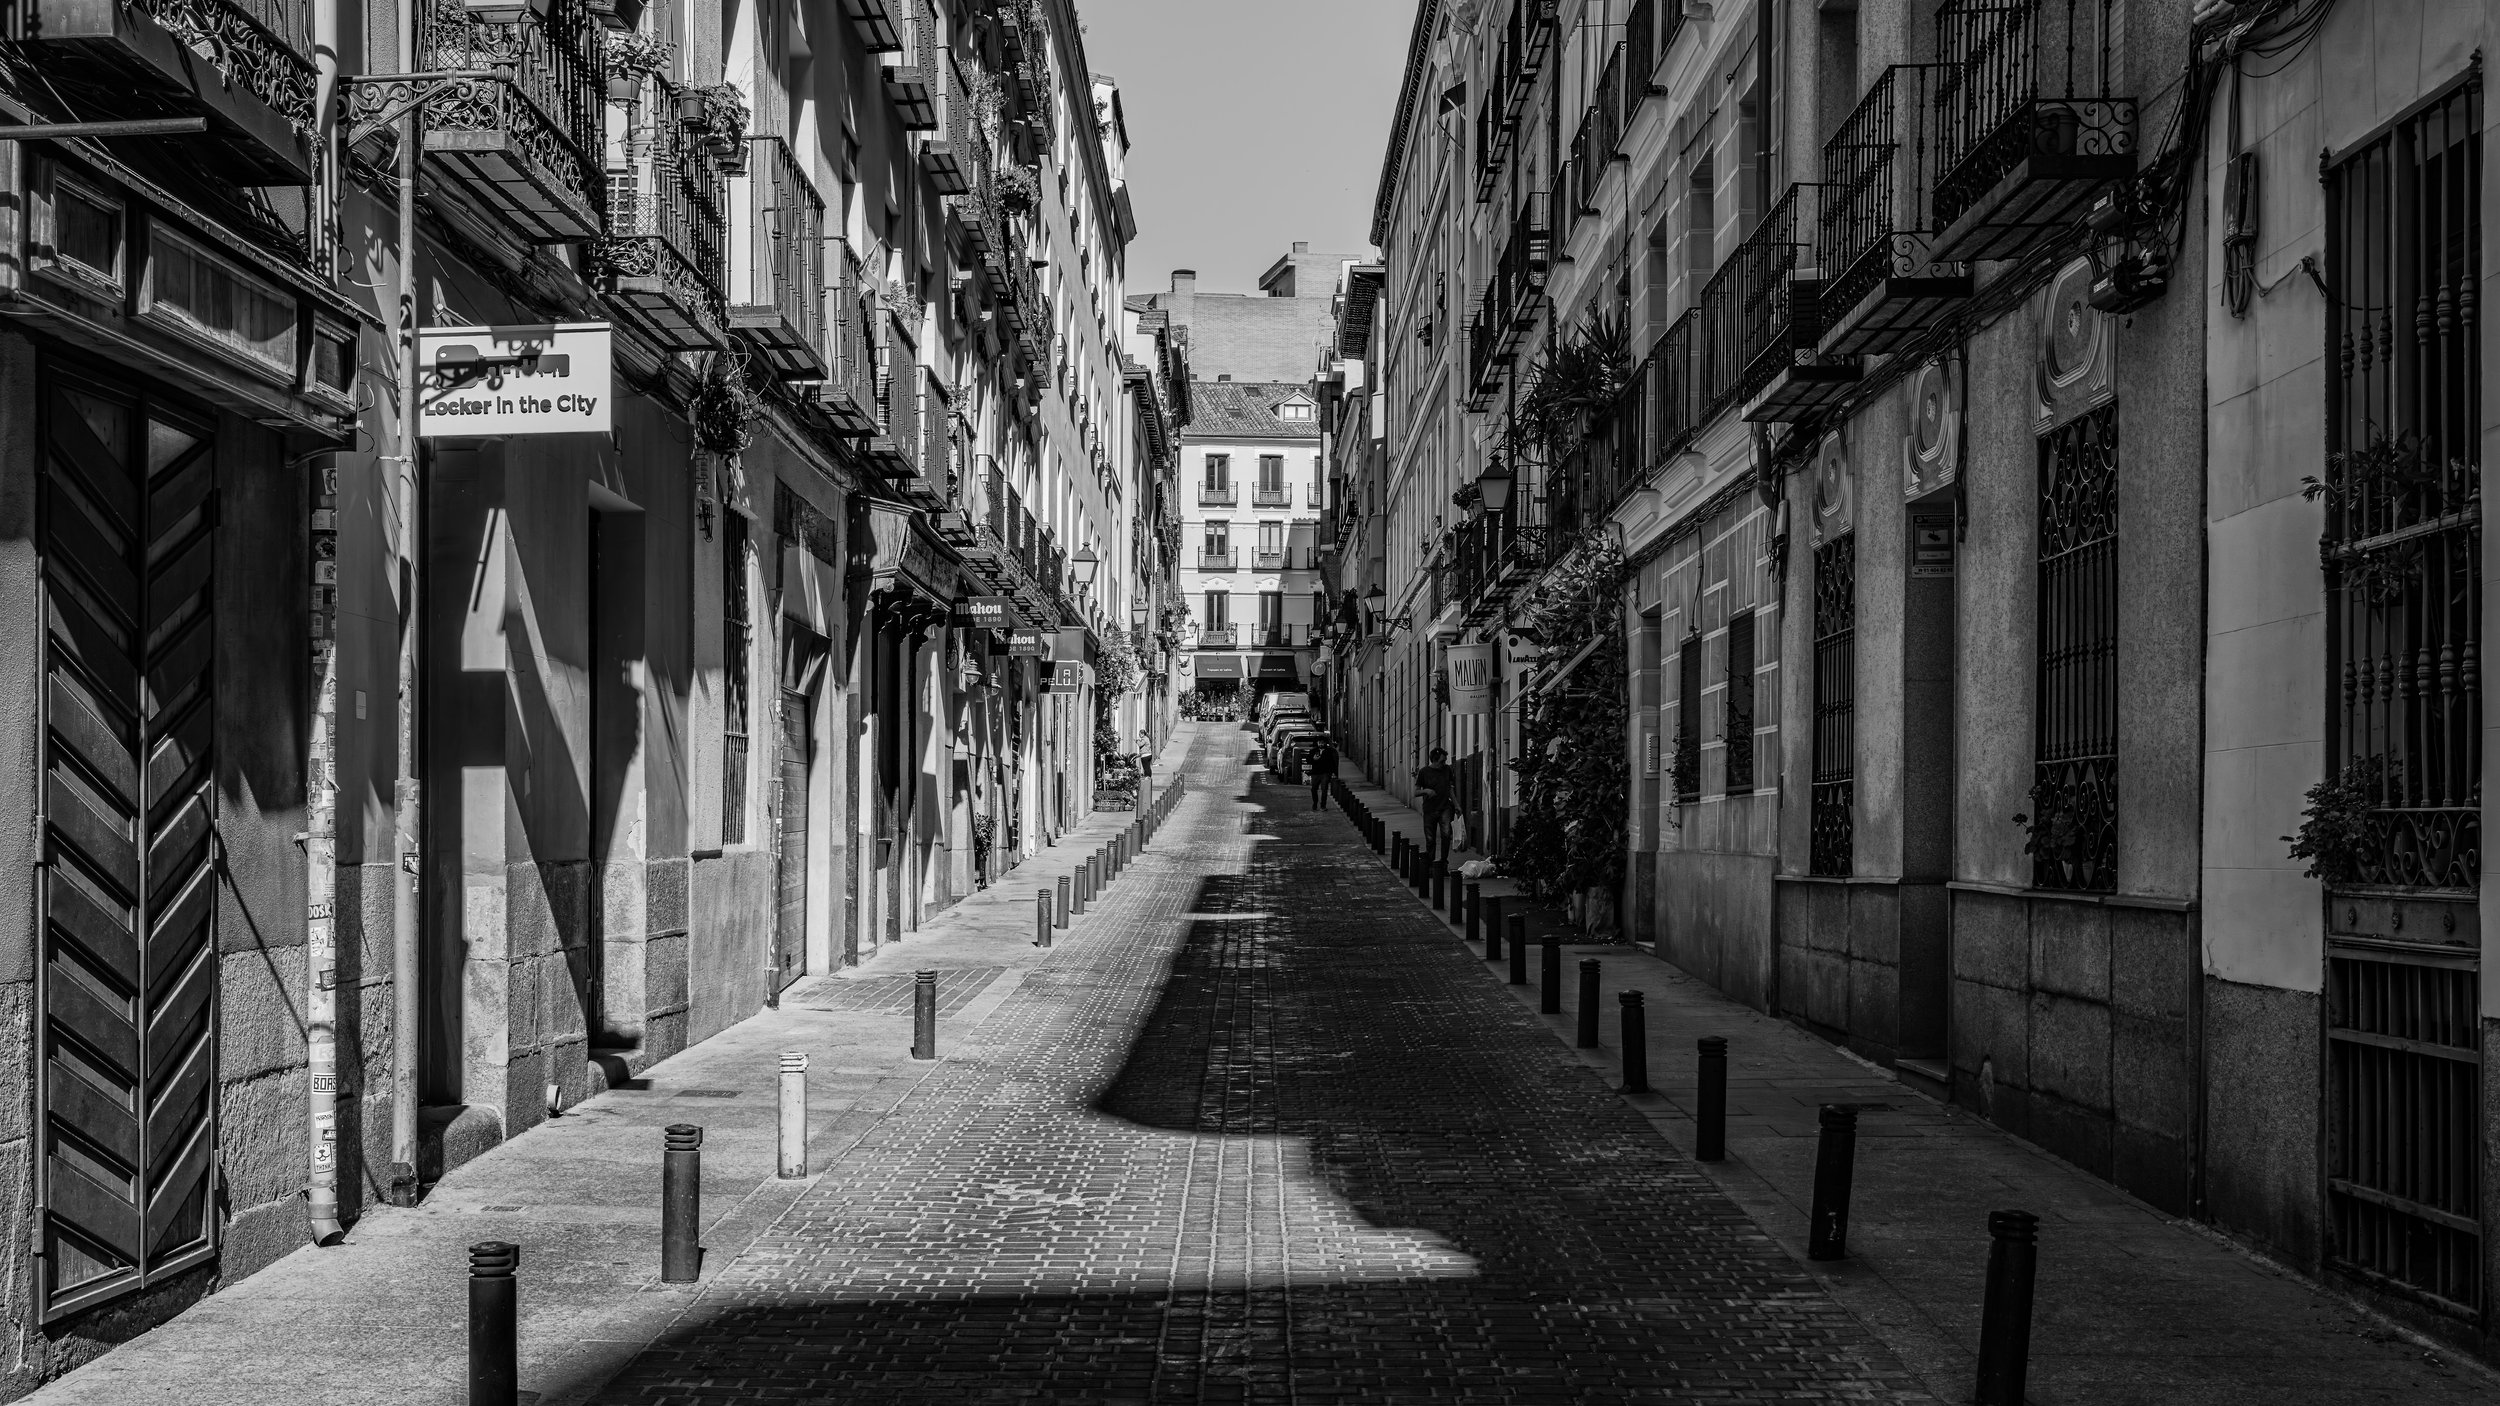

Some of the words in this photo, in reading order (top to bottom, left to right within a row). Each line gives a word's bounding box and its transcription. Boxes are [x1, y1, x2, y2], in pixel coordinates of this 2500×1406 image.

[424, 397, 492, 416] Locker
[496, 395, 514, 414] in
[519, 395, 552, 414] the
[556, 394, 598, 416] City
[955, 601, 1002, 615] Mahou
